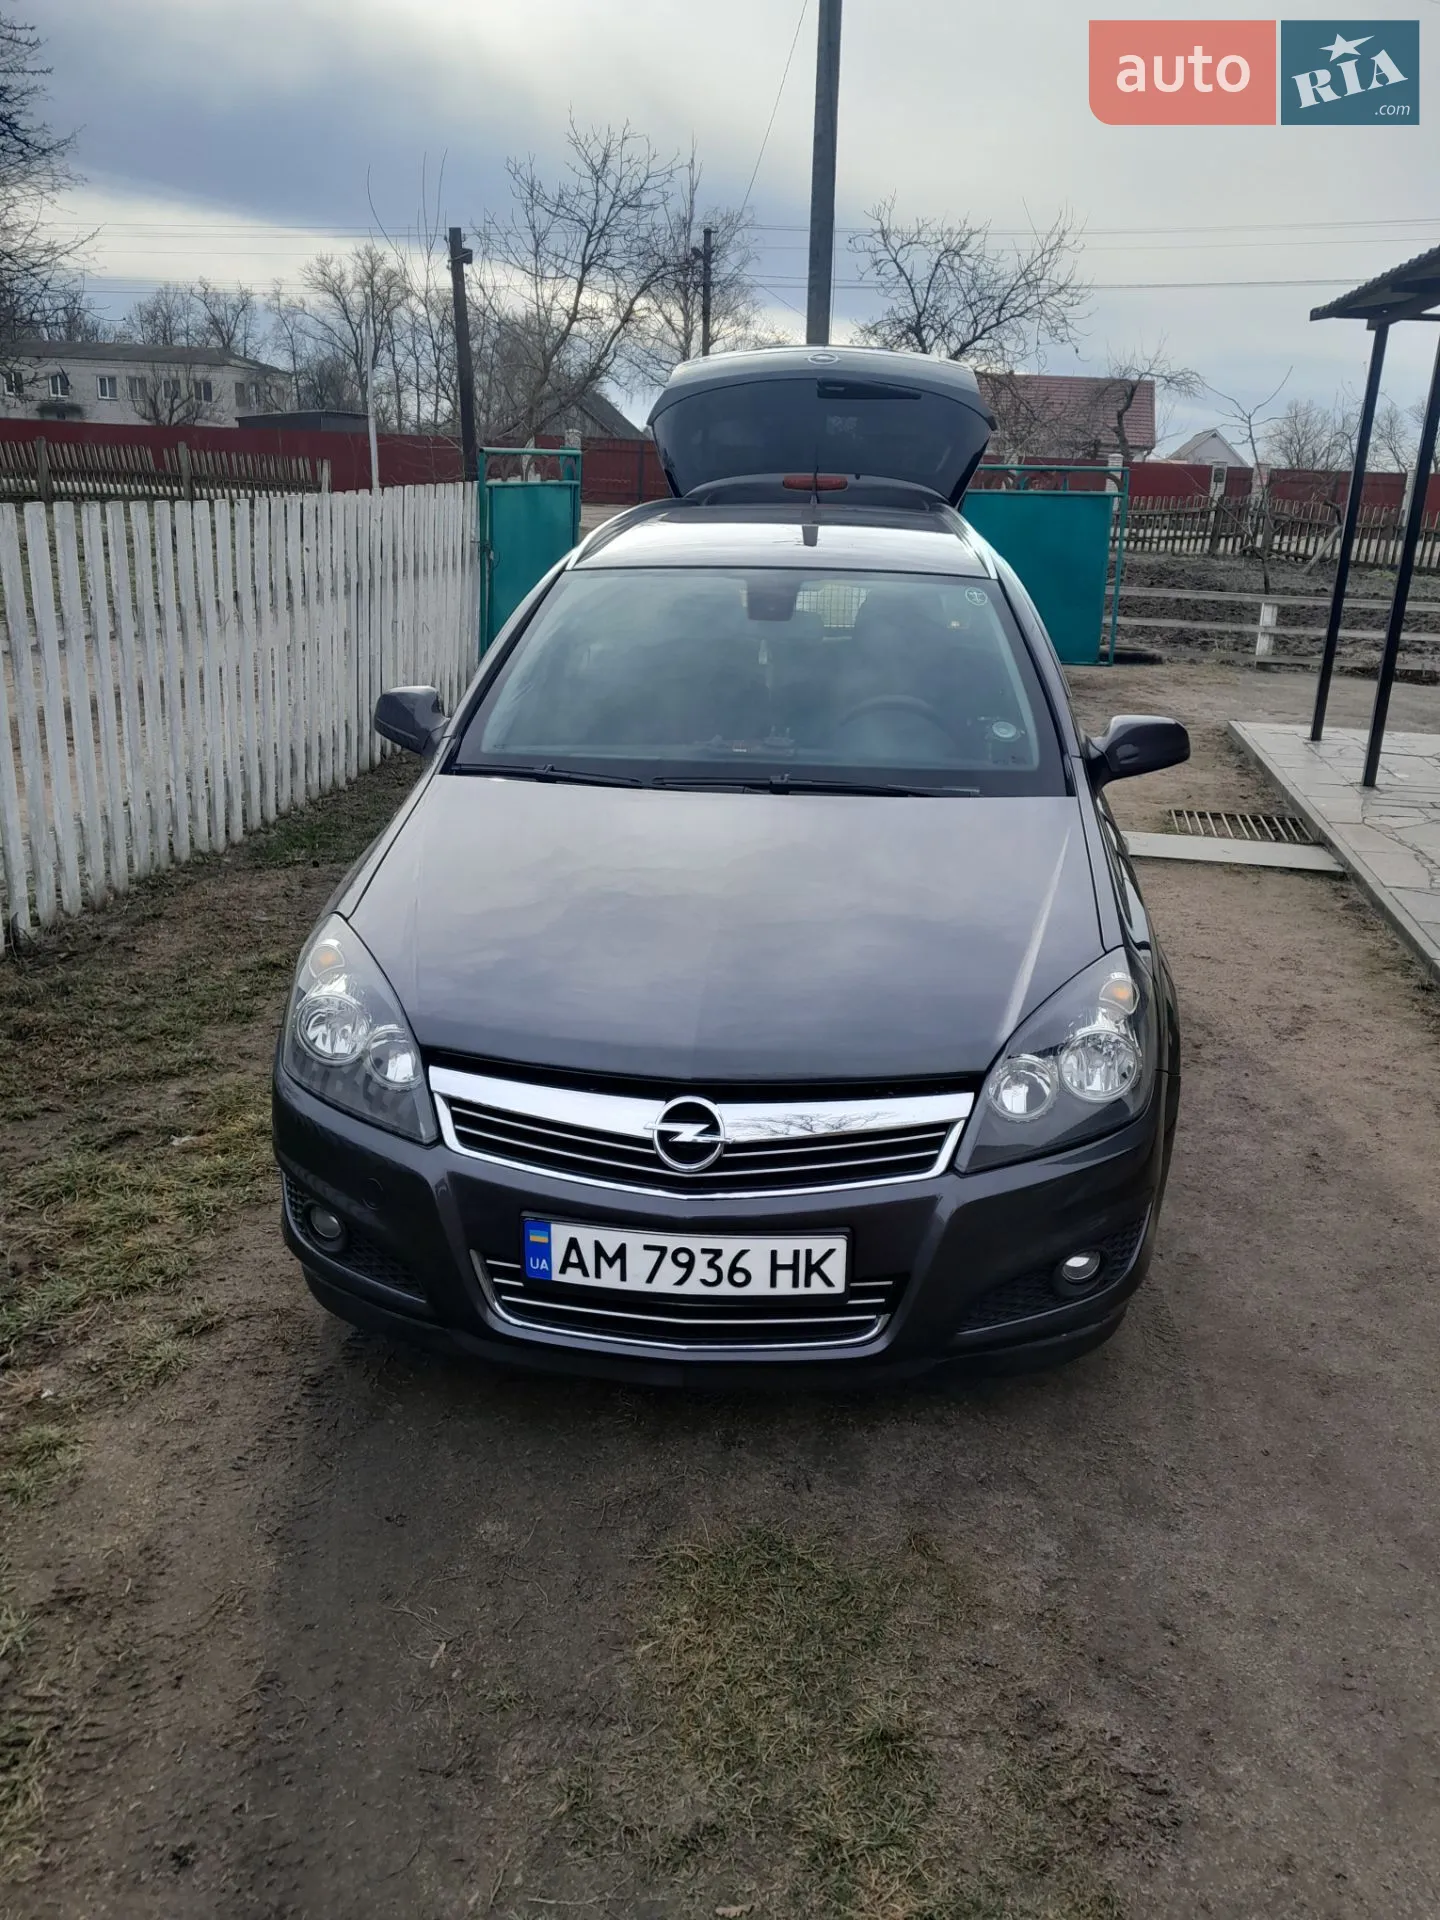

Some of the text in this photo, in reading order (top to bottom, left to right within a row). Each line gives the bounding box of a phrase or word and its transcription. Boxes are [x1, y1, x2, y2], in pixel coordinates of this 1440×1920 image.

[530, 1256, 549, 1271] UA
[558, 1237, 837, 1288] AM 7936 HK
